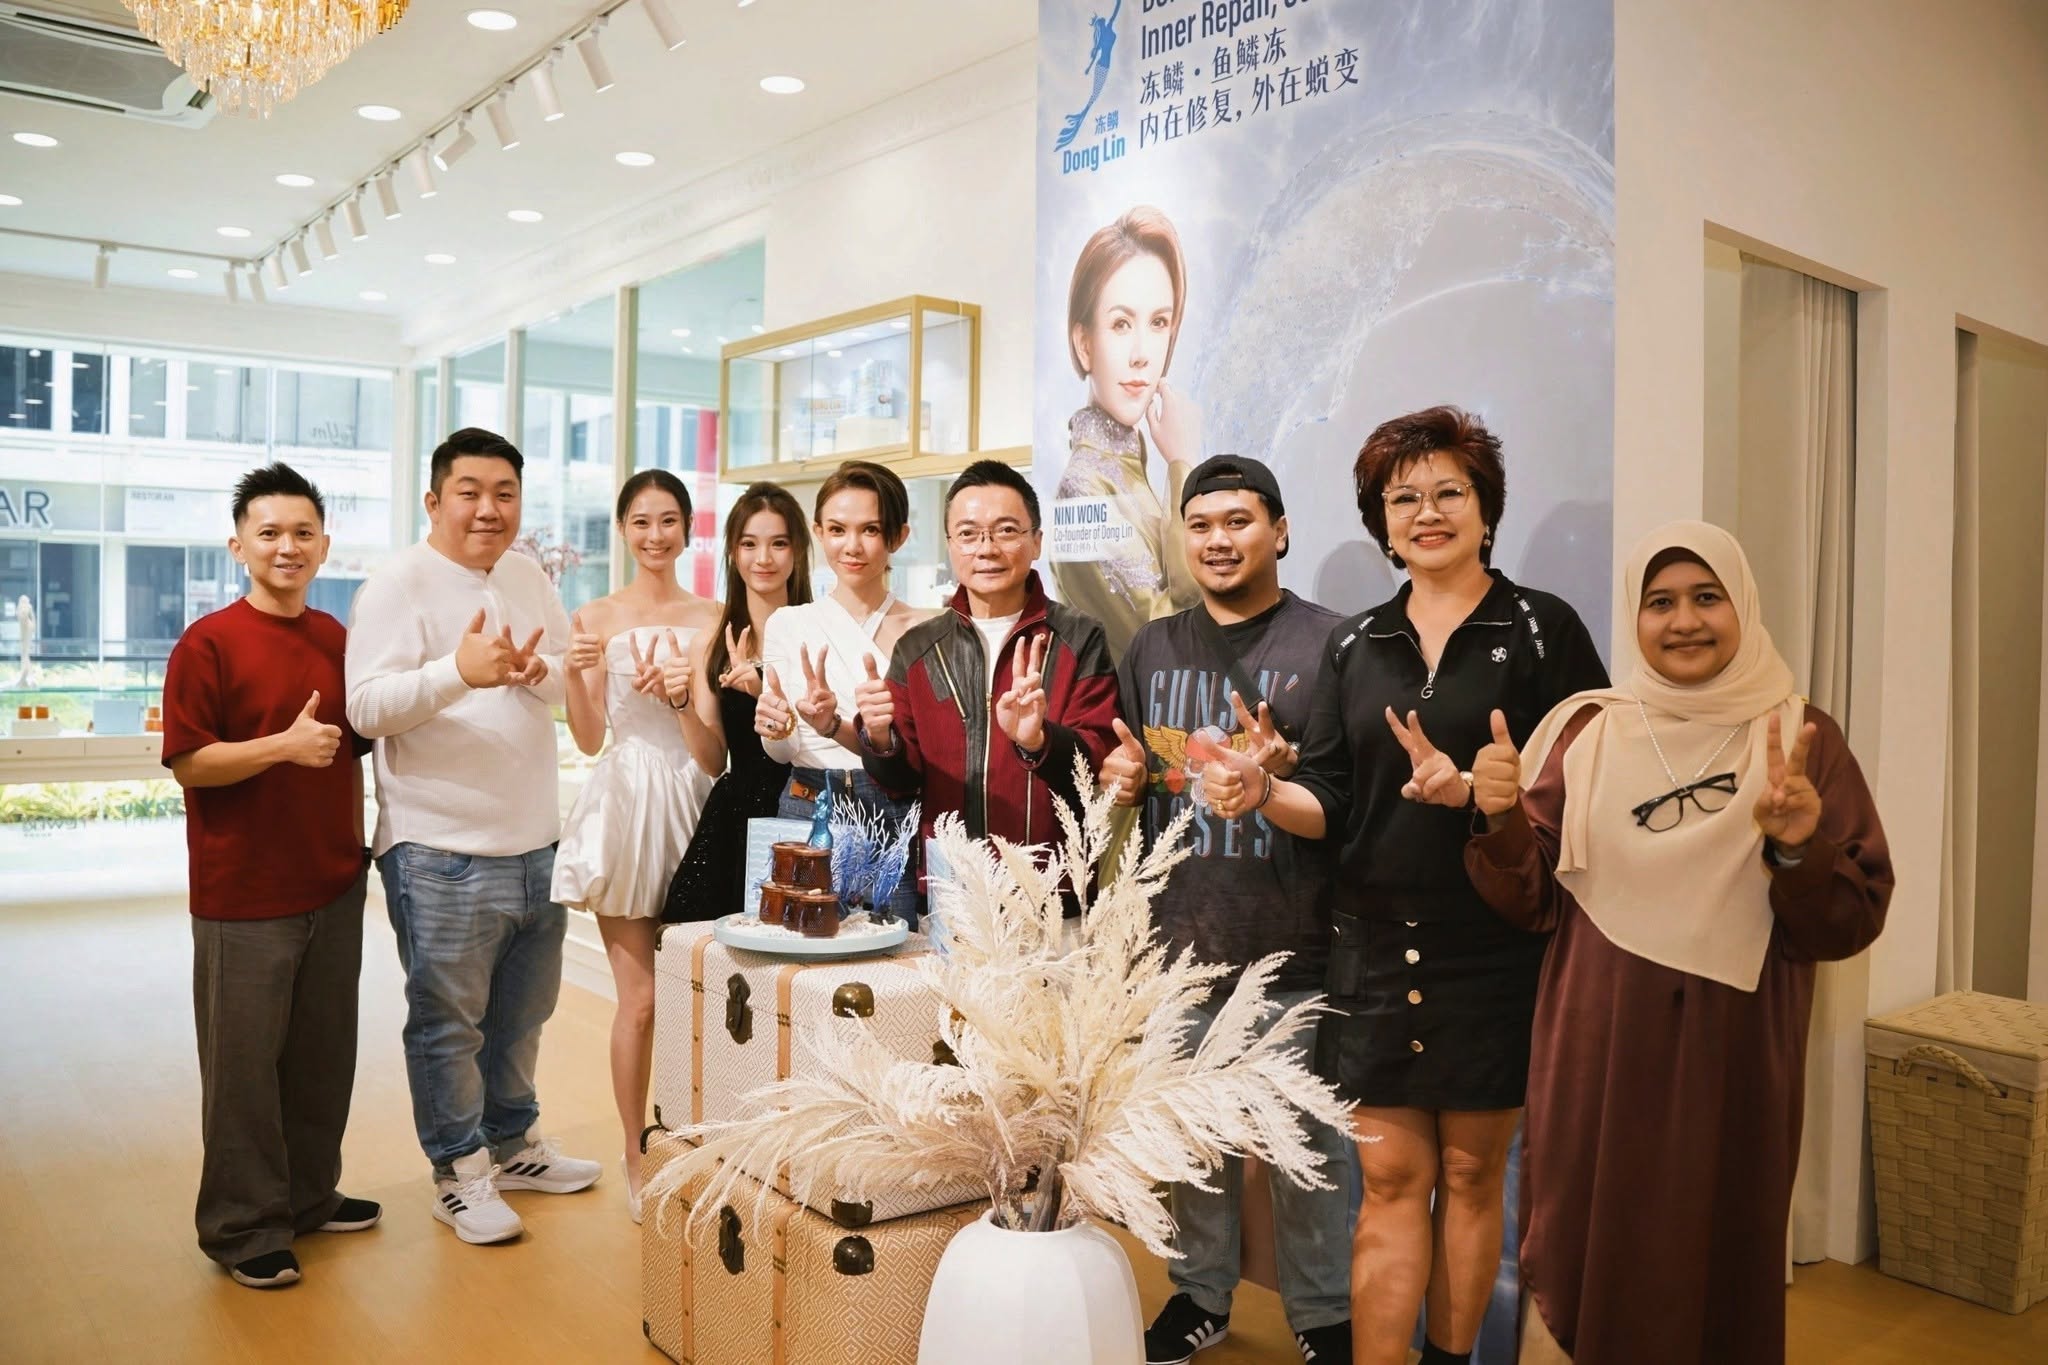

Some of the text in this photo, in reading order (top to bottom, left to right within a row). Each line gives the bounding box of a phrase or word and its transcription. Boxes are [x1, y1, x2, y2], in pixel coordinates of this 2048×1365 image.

[1142, 13, 1196, 59] Inner
[1063, 134, 1125, 174] Dong Lin
[1054, 503, 1107, 526] NINI WONG
[1054, 523, 1133, 542] Co-founder of Dong Lin
[1148, 669, 1239, 733] GUNS
